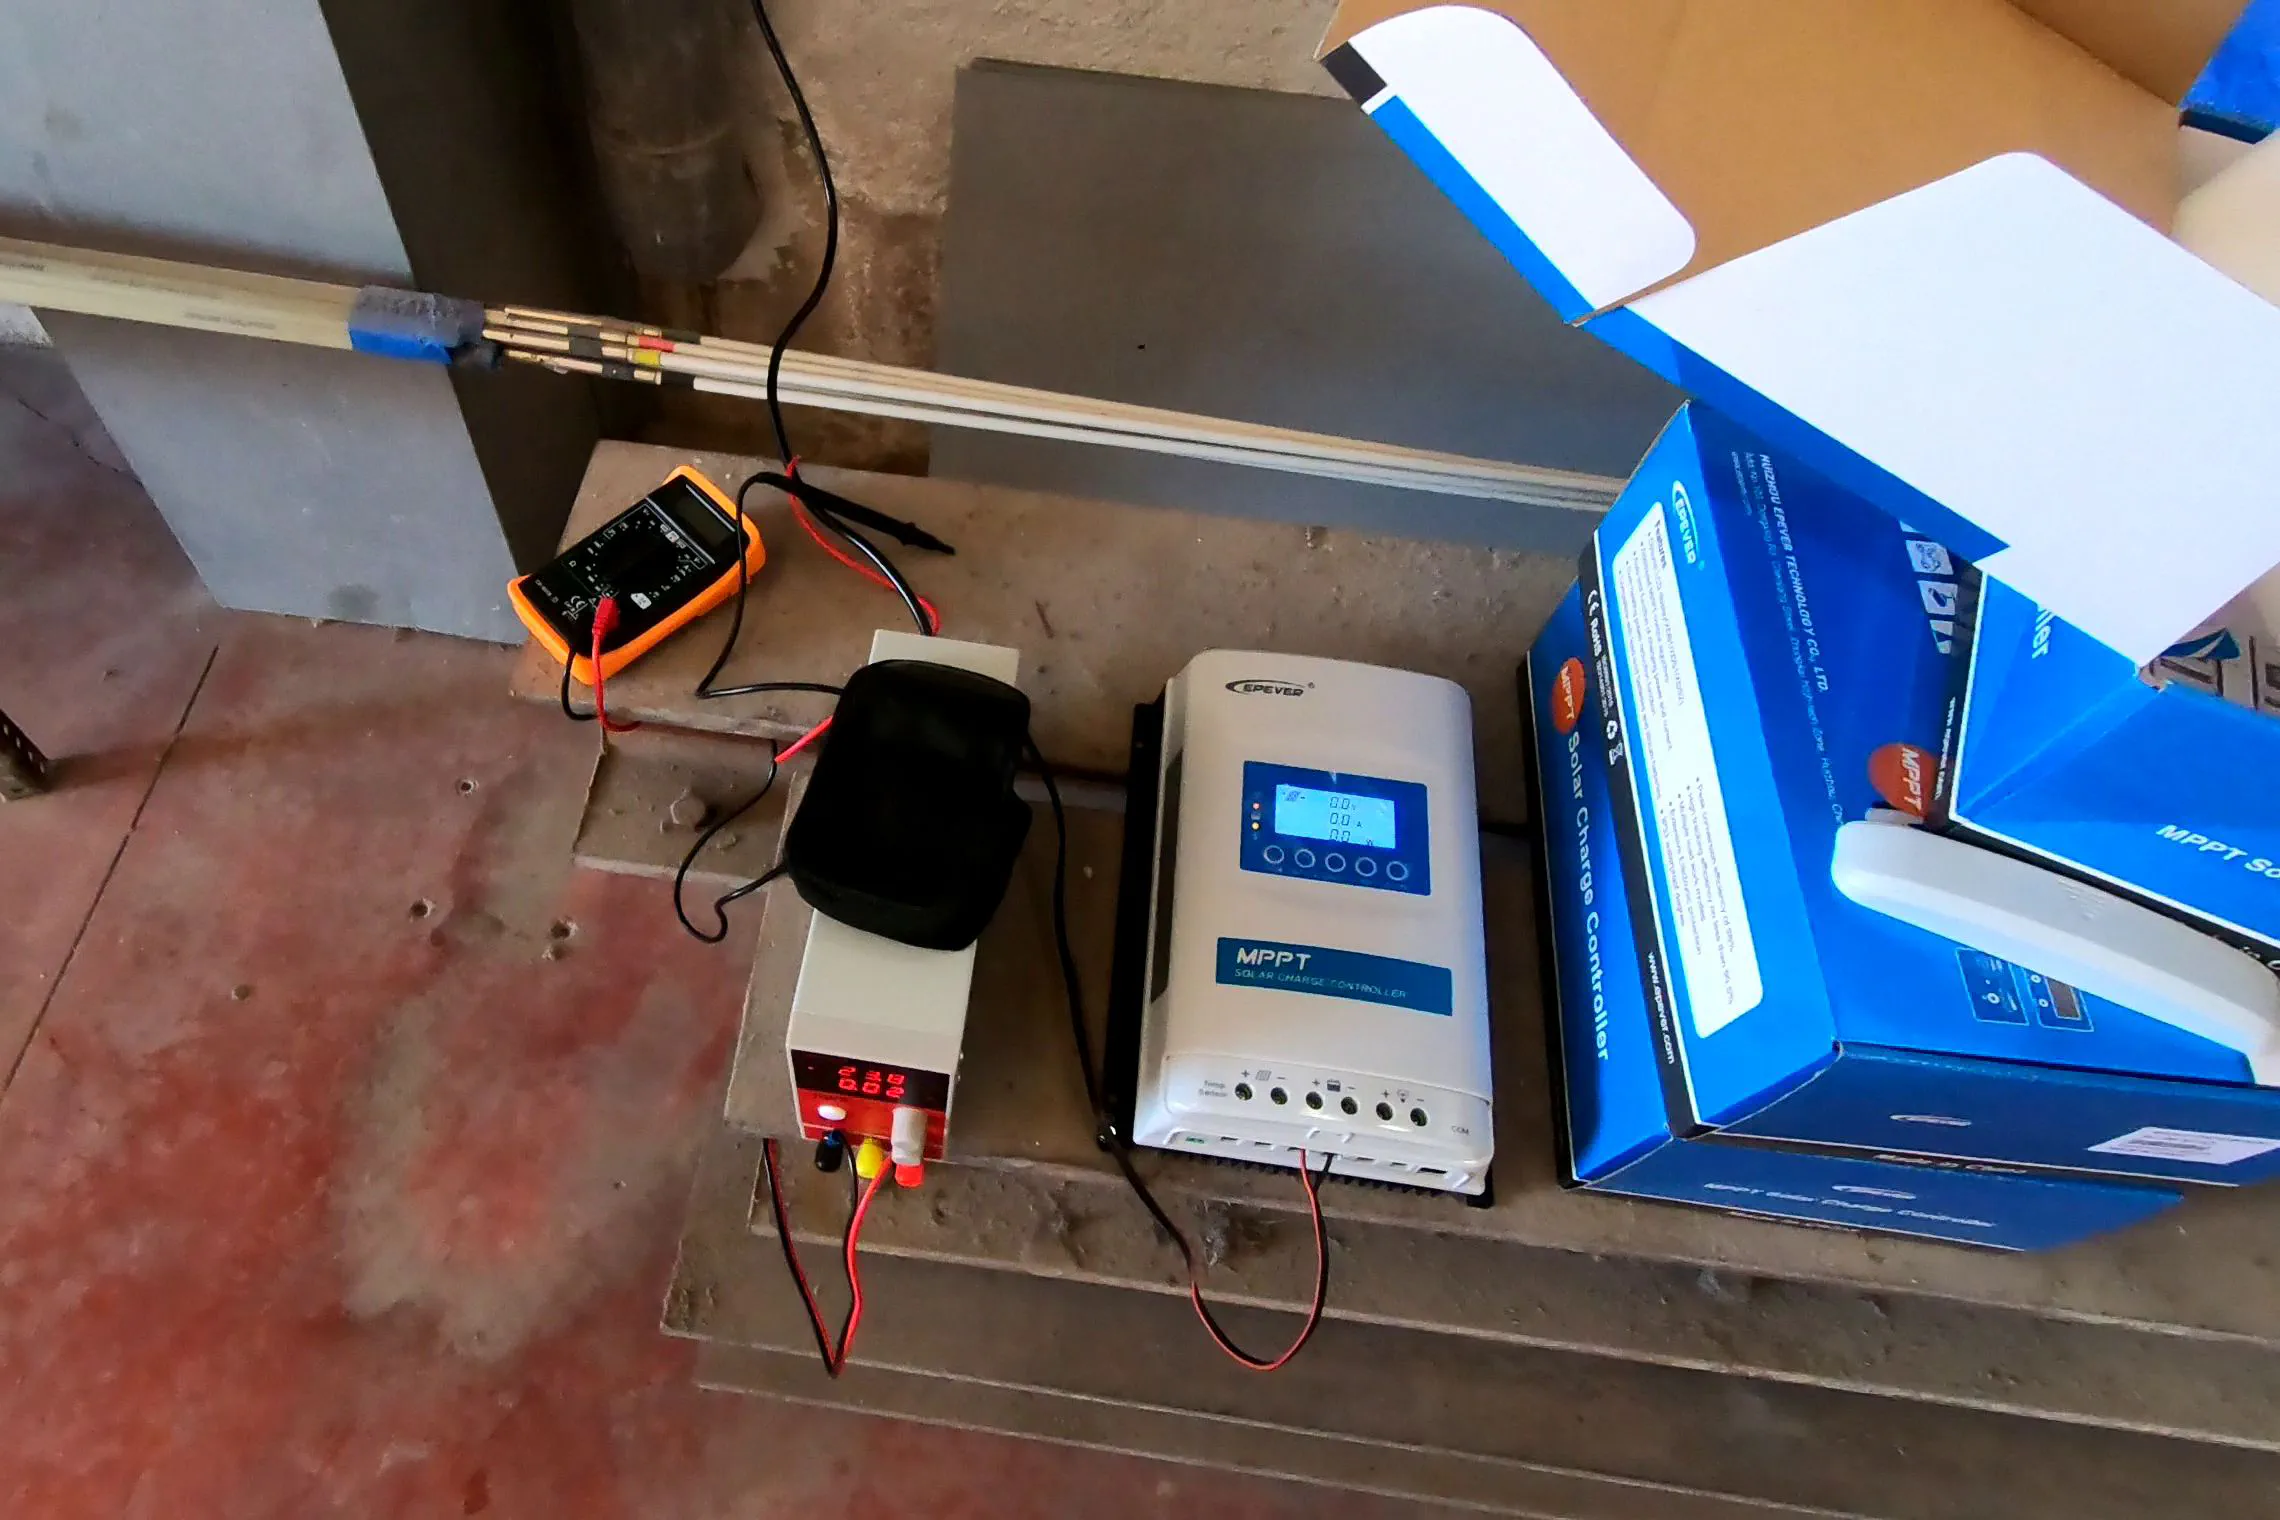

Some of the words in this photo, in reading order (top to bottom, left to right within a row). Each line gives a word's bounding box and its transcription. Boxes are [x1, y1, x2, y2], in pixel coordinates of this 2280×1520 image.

[1675, 497, 1697, 565] EPEVER
[1760, 454, 1781, 505] HUIZHOU
[1774, 506, 1794, 551] EPEVER
[1785, 555, 1815, 637] TECHNOLOGY
[1242, 683, 1304, 698] EPEVER
[1560, 665, 1576, 720] MPPT
[1568, 731, 1584, 800] Solar
[1902, 746, 1922, 811] MPPT
[1575, 806, 1593, 906] Charge
[2156, 824, 2248, 861] MPPT
[1234, 968, 1275, 980] SOLAR
[1277, 973, 1325, 988] CHARGE
[1329, 979, 1407, 999] CONTROLLER
[1236, 947, 1311, 970] MPPT
[1585, 912, 1609, 1060] Controller
[1648, 952, 1676, 1065] www.epever.com
